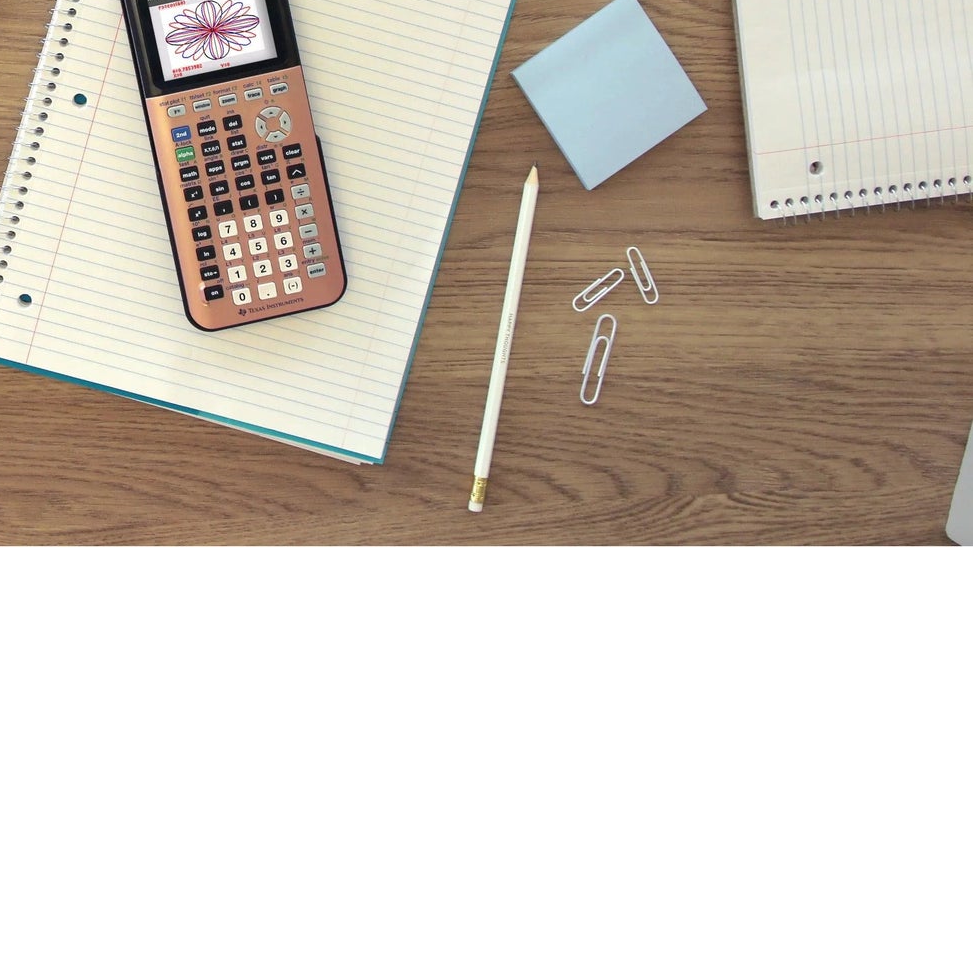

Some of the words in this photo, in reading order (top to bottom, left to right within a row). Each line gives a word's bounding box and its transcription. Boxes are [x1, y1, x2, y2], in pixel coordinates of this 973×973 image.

[272, 85, 287, 94] graph
[231, 139, 243, 147] stat
[285, 148, 301, 156] clear
[233, 159, 249, 167] prgm
[275, 214, 283, 223] 9
[250, 219, 257, 228] 8
[224, 225, 231, 234] 7
[197, 231, 207, 239] log
[280, 237, 287, 246] 6
[255, 242, 262, 251] 5
[230, 248, 237, 257] 4
[285, 259, 292, 268] 3
[259, 265, 266, 273] 2
[309, 267, 325, 275] enter
[239, 292, 246, 302] 0
[248, 306, 266, 314] TEXAS
[266, 297, 304, 309] INSTRUMENTS
